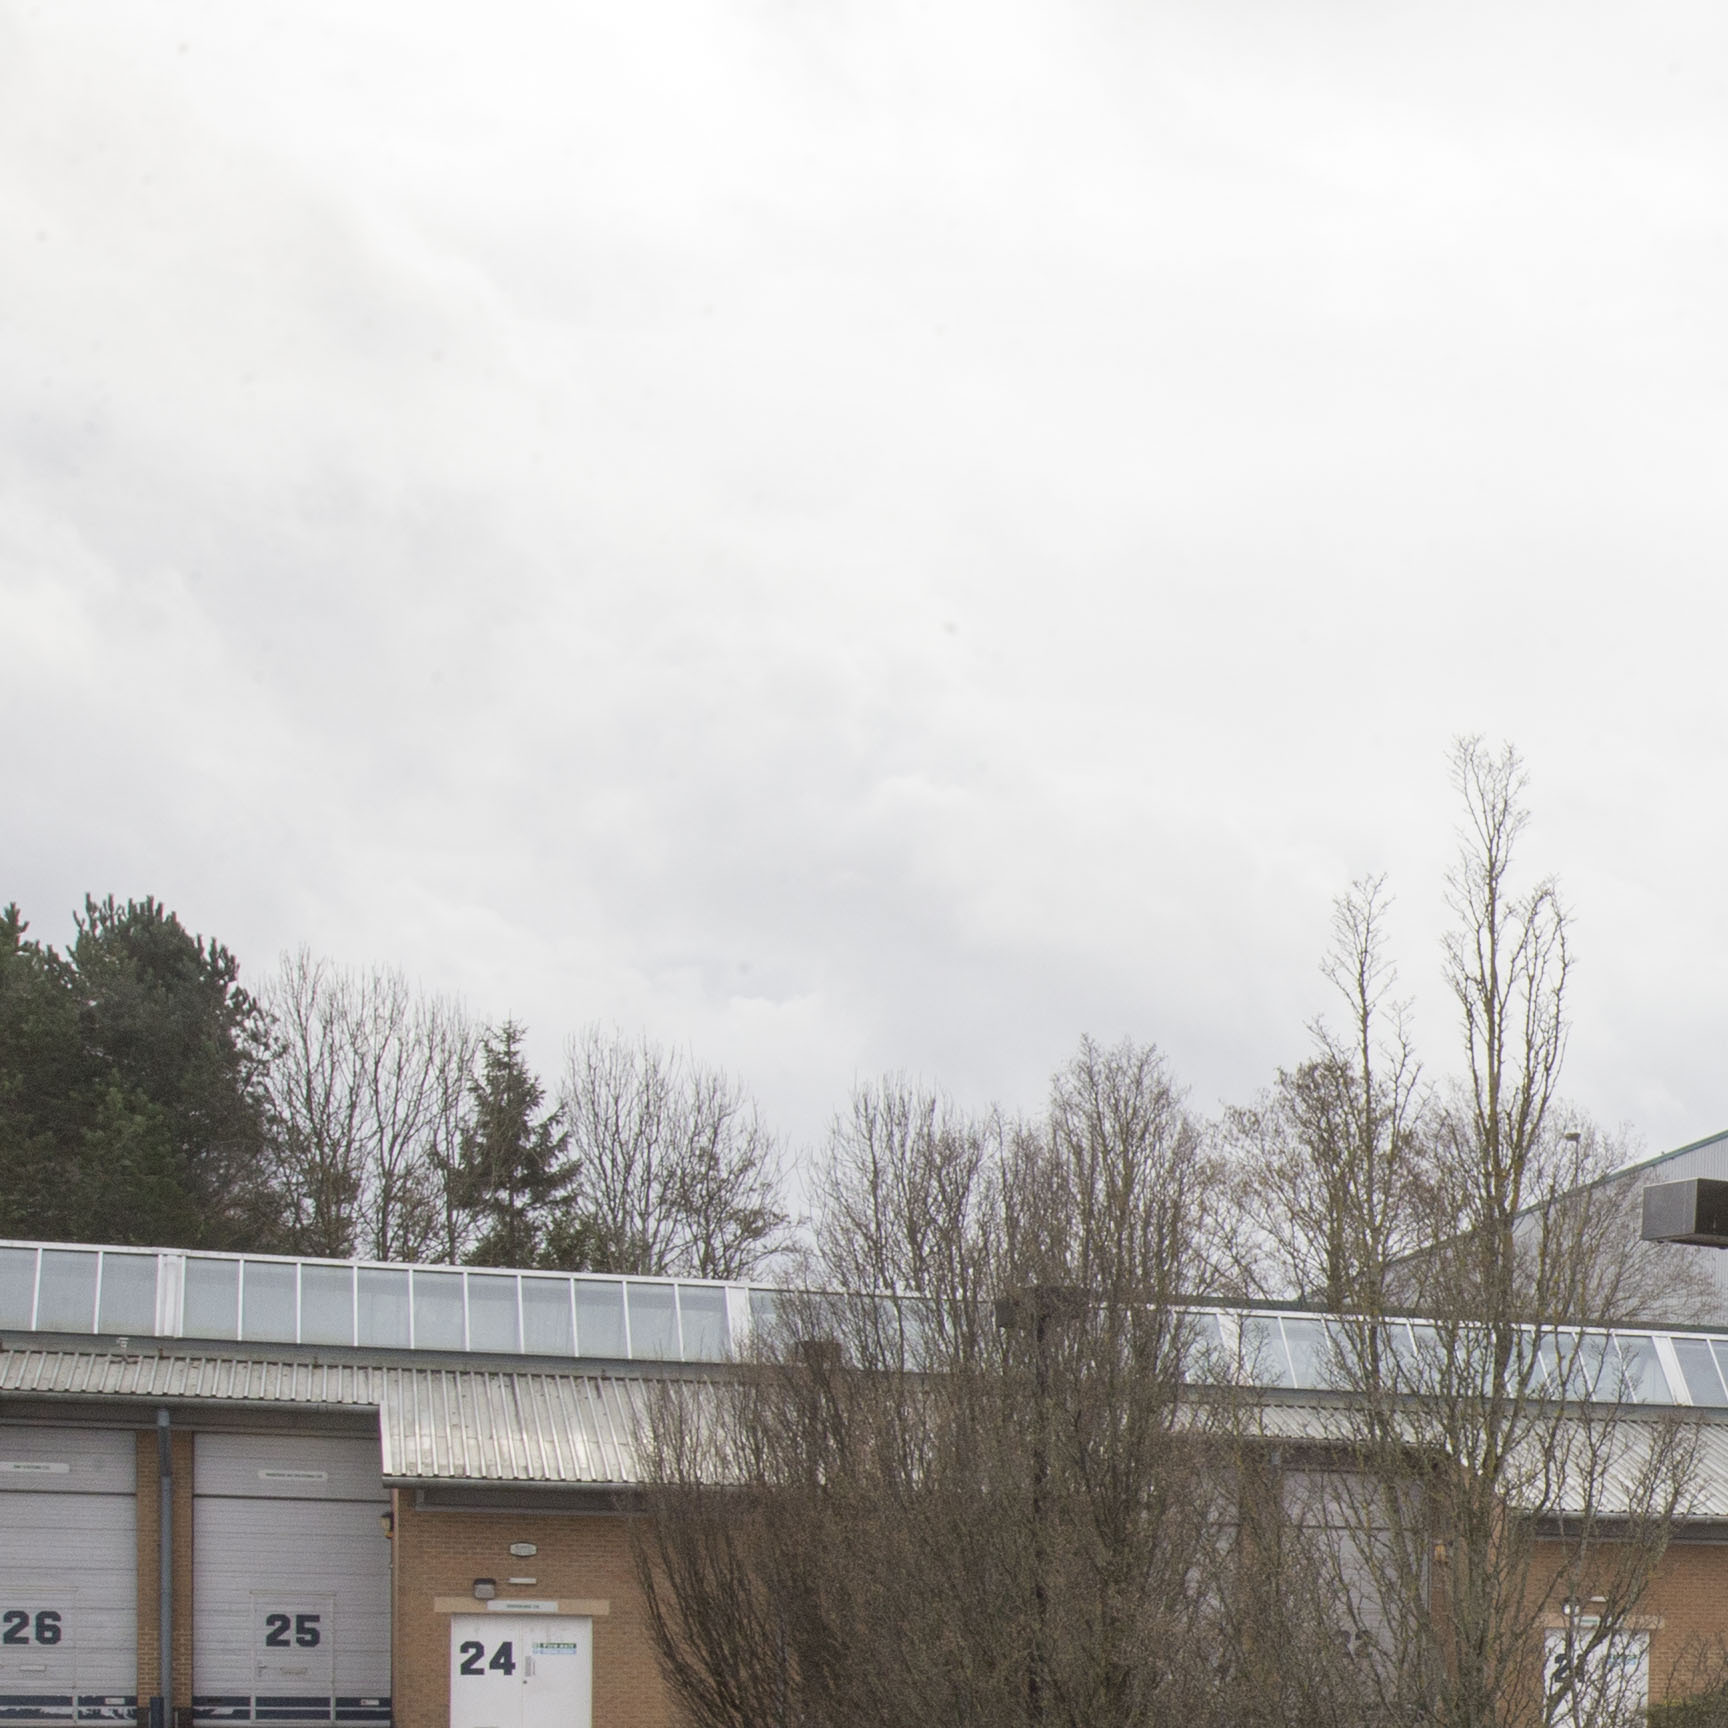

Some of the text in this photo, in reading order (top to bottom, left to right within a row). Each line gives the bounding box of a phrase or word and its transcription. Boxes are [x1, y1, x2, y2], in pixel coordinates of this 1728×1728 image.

[3, 1610, 62, 1645] 26
[266, 1613, 320, 1647] 25
[460, 1641, 516, 1676] 24
